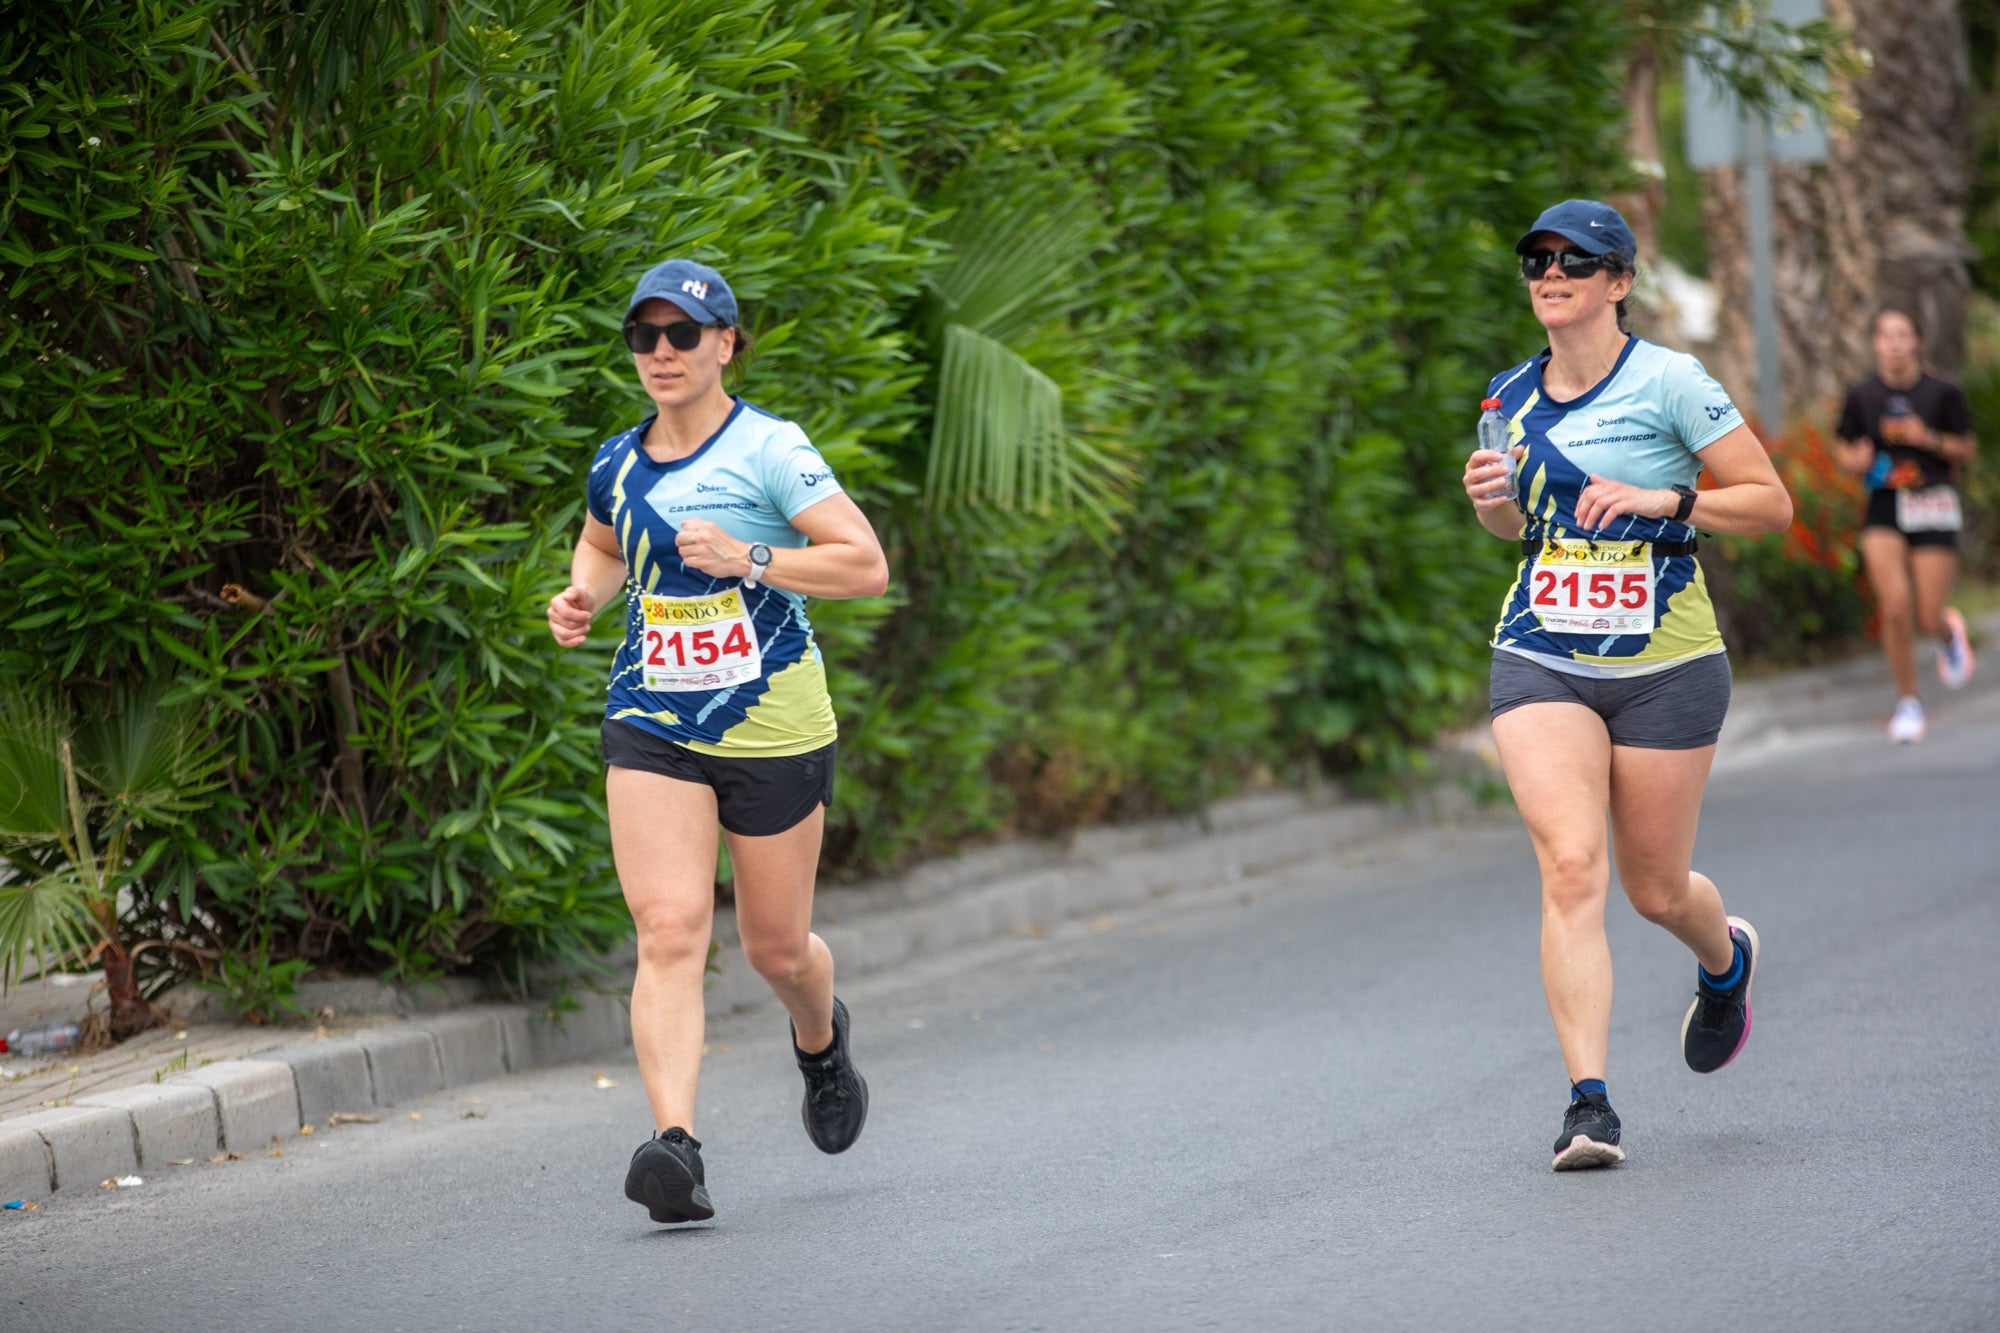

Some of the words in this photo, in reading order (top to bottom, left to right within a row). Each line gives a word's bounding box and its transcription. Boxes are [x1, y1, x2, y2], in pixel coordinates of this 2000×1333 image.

[1564, 550, 1626, 562] FONDO
[1534, 570, 1648, 609] 2155
[664, 606, 718, 619] FONDO
[646, 622, 752, 667] 2154
